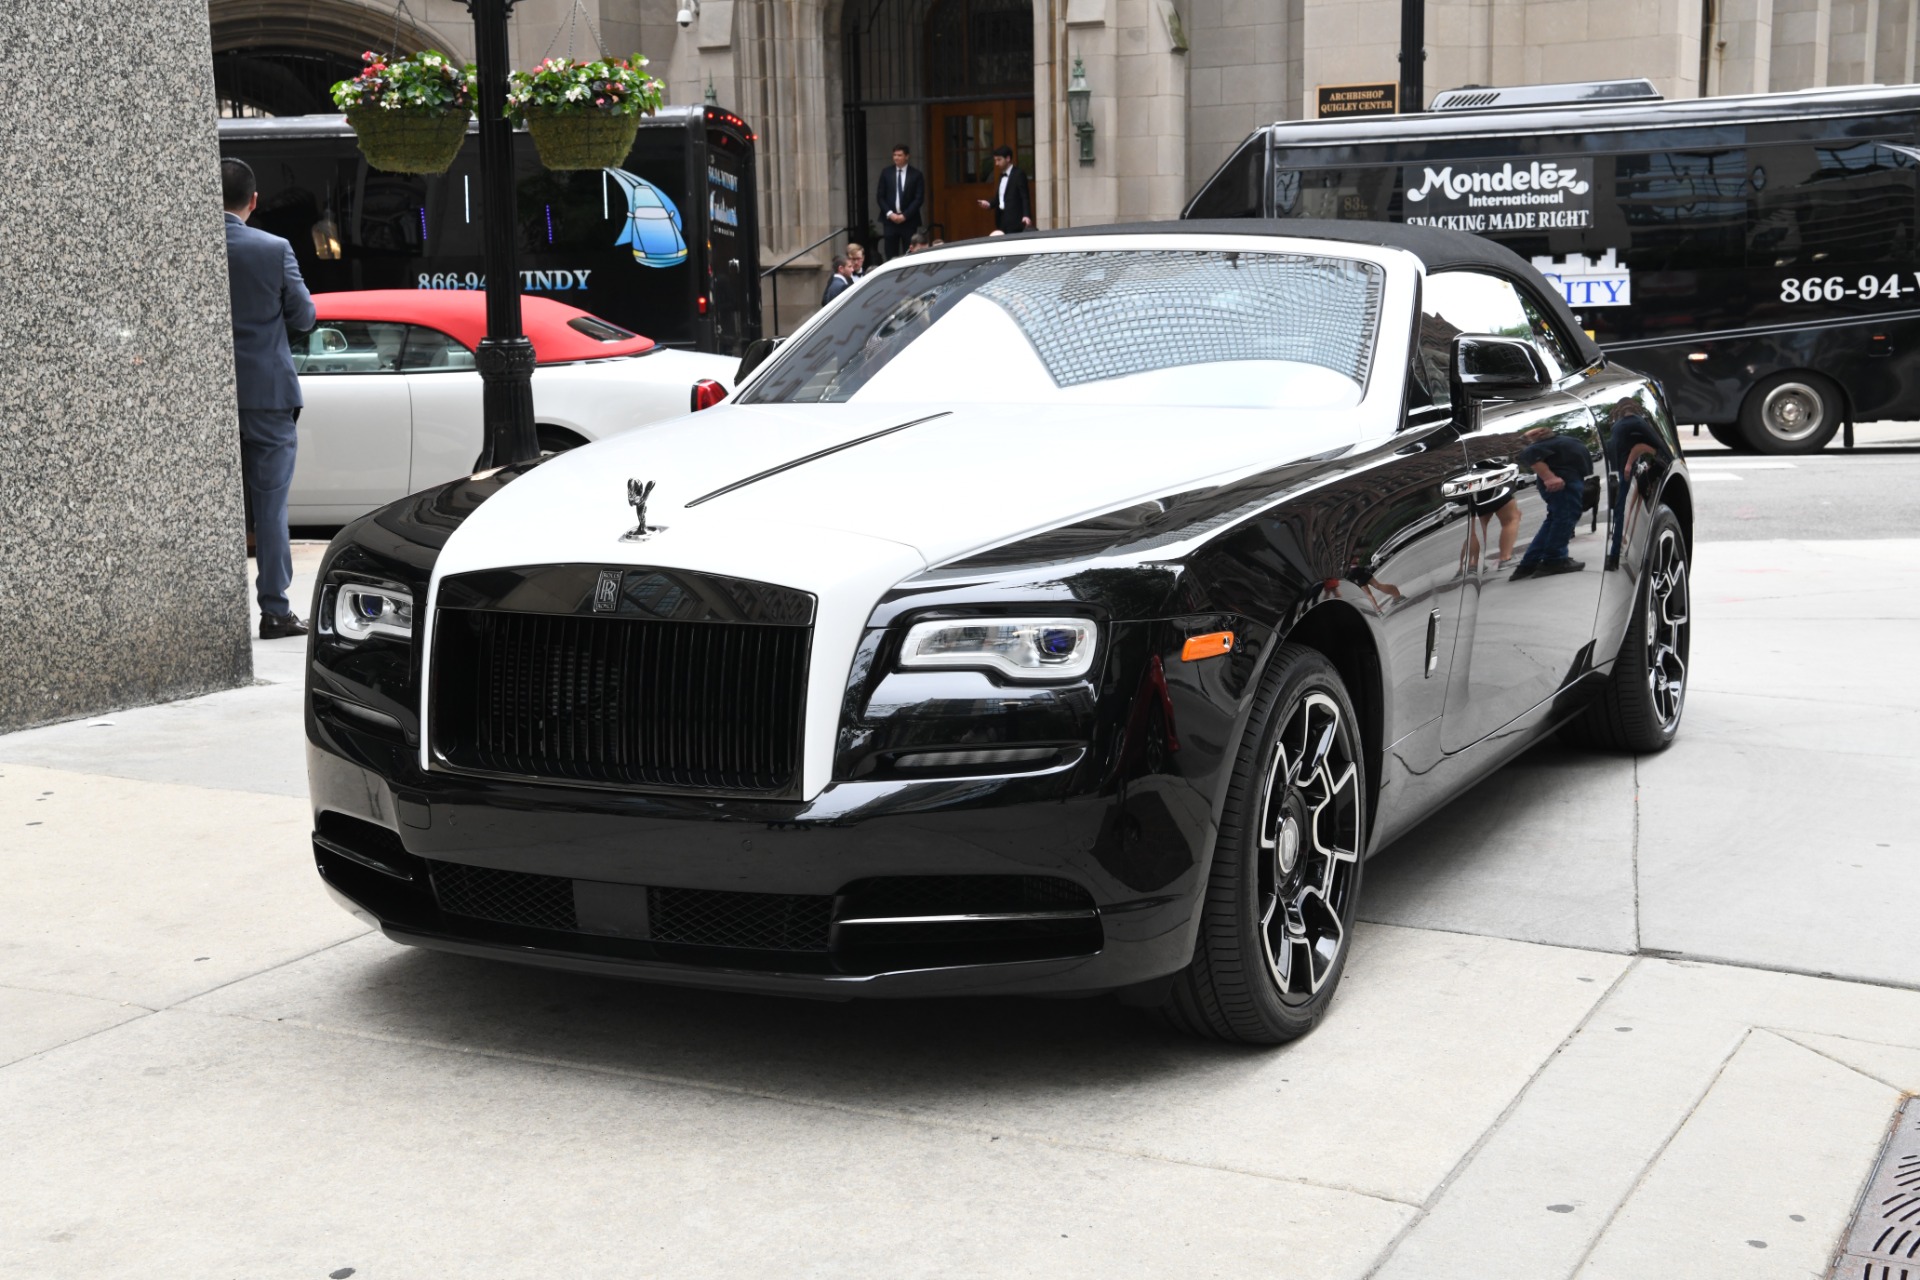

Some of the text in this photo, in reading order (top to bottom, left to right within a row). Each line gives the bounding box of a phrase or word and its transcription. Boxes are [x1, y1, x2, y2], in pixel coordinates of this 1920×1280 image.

[1329, 90, 1384, 101] ARCHBISHOP
[1320, 100, 1393, 114] QUIGLEY CENTER
[1407, 161, 1589, 202] Mondelēz
[1468, 190, 1564, 208] International
[1407, 210, 1589, 231] SNACKING MADE RIGHT
[1780, 271, 1920, 303] 866-94-
